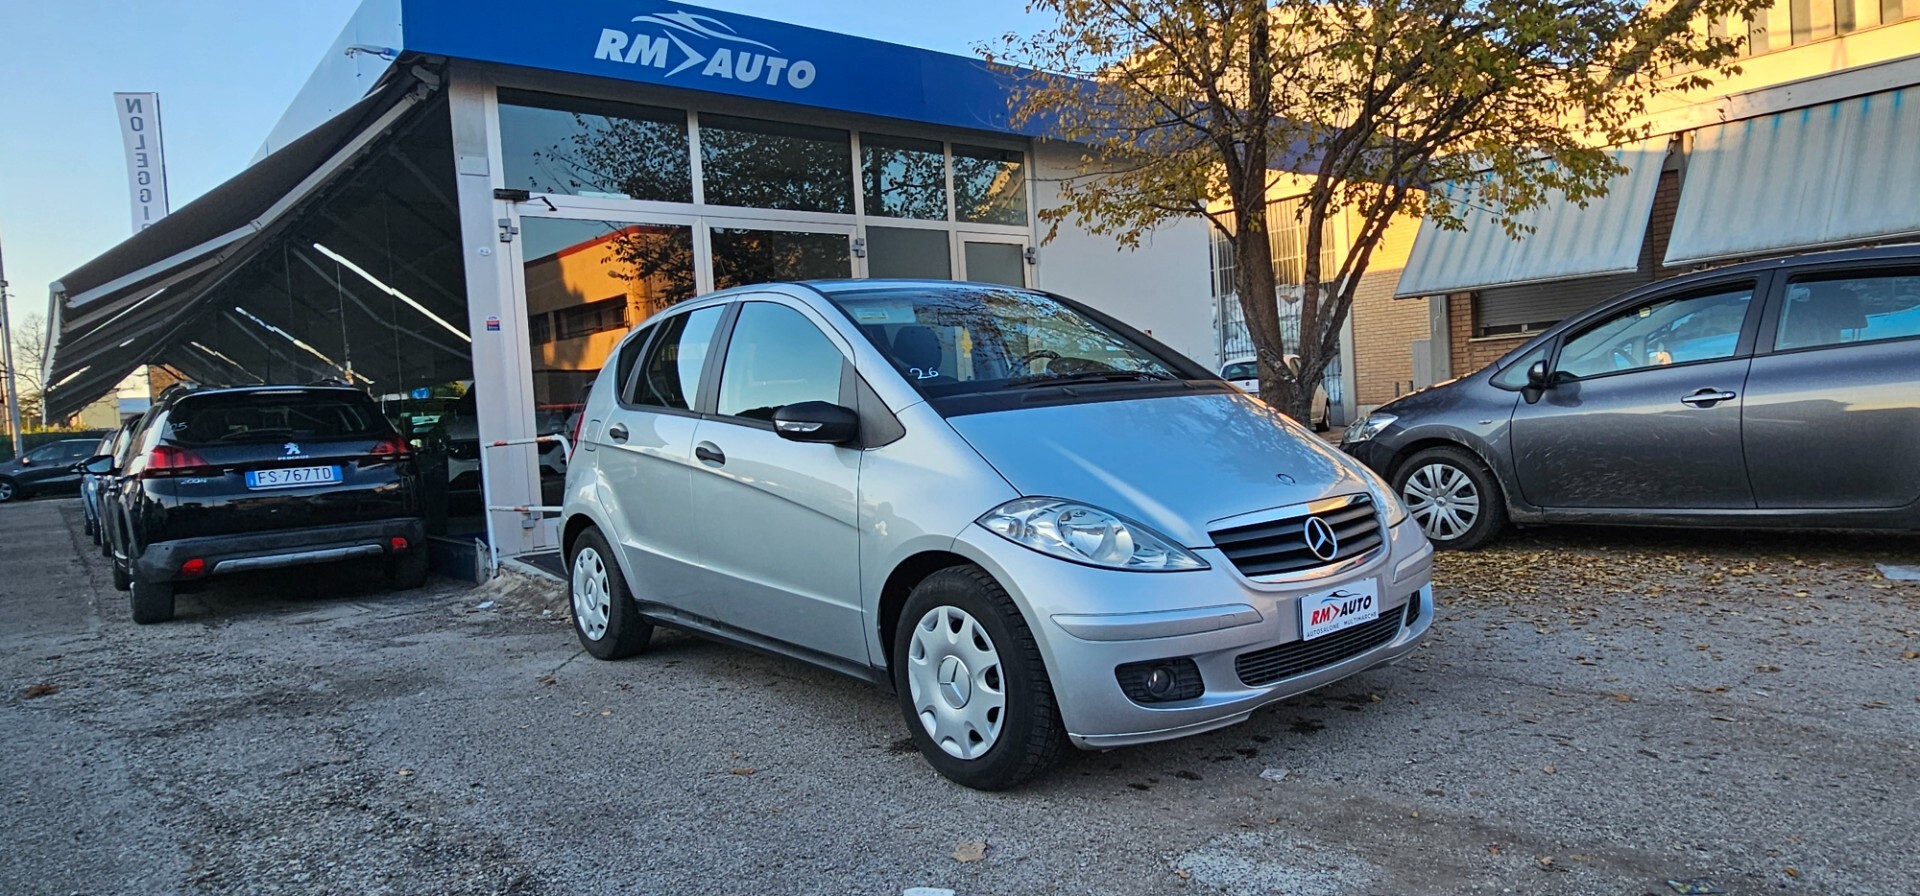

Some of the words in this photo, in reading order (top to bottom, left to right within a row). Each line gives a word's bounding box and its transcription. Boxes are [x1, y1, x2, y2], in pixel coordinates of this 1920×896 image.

[594, 28, 669, 69] RM
[702, 48, 817, 89] AUTO
[910, 367, 939, 379] 26
[1306, 622, 1340, 638] AUTOSALONE
[1343, 611, 1377, 626] MULTIMARCHE
[1311, 607, 1331, 626] RM
[1339, 595, 1372, 617] AUTO
